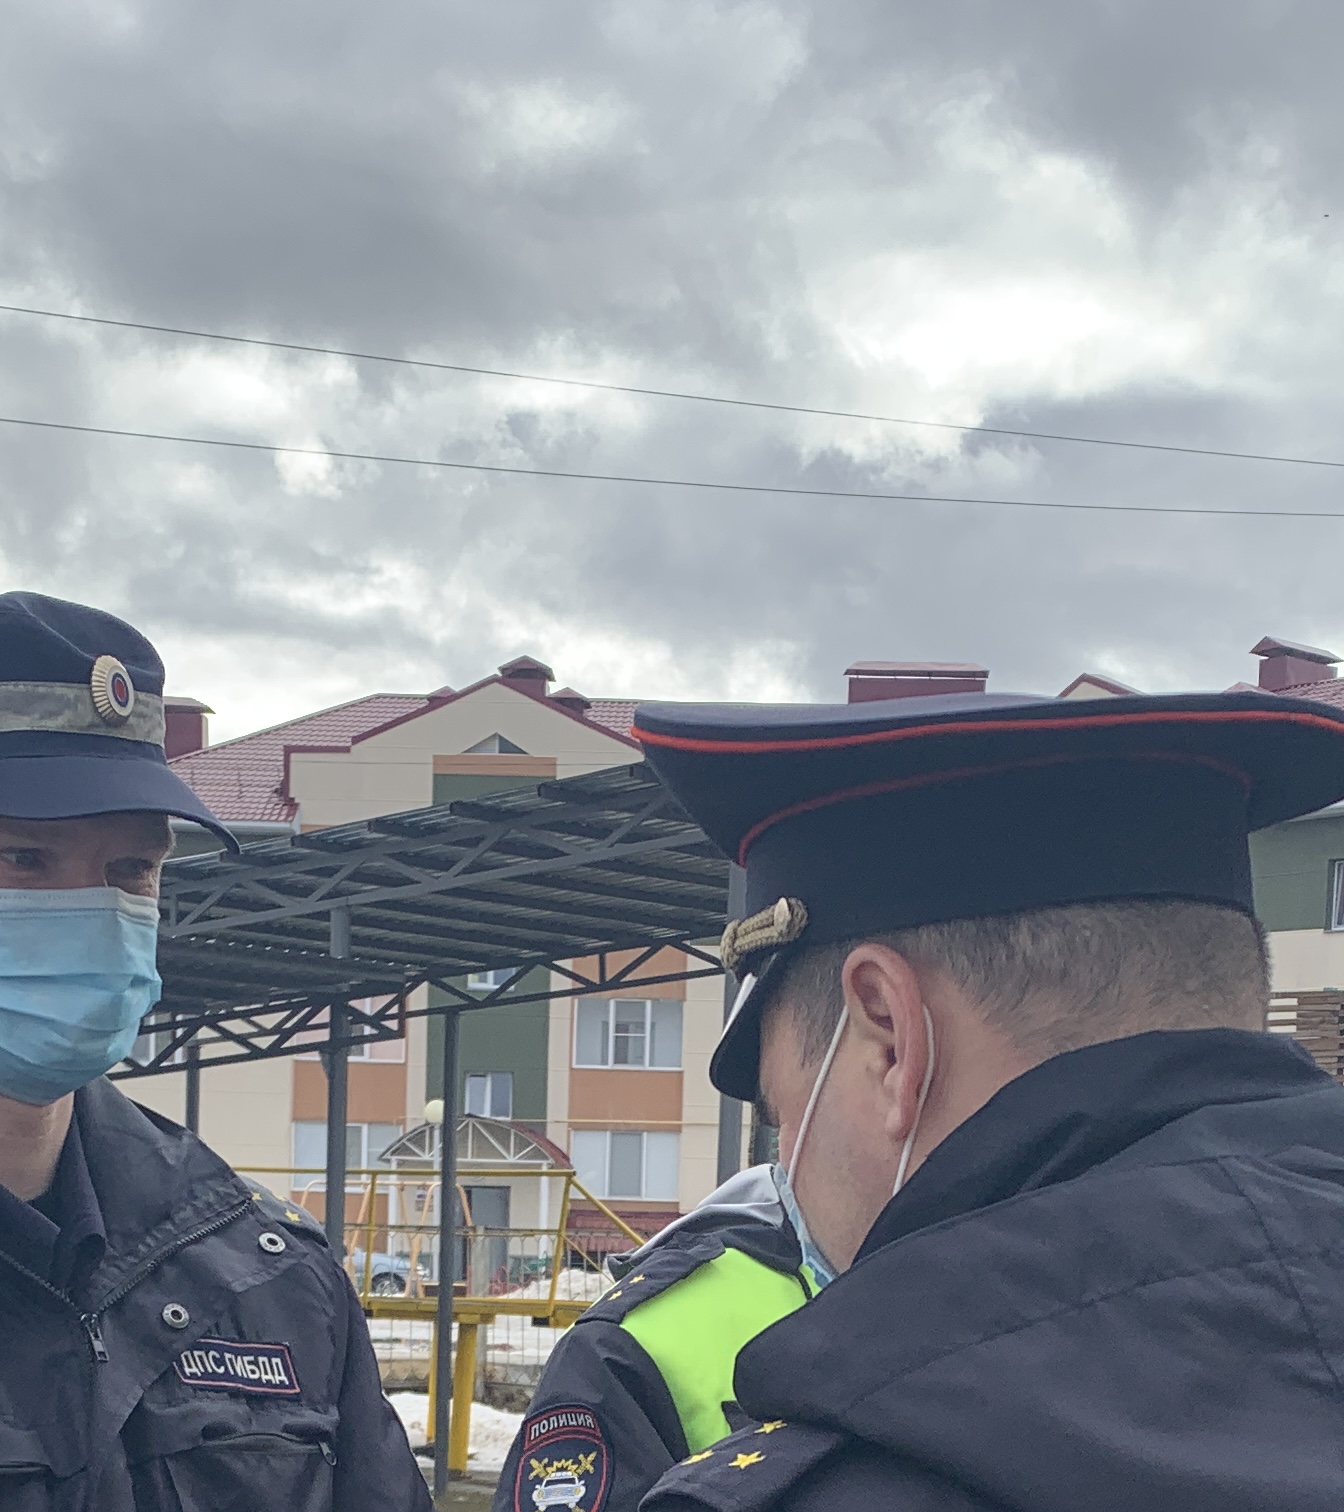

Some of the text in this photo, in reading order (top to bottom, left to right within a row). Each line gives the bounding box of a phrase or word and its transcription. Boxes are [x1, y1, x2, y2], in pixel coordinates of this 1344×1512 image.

[180, 1350, 289, 1386] ДПС ГИБДД
[530, 1414, 595, 1441] ПОЛИЦИЯ
